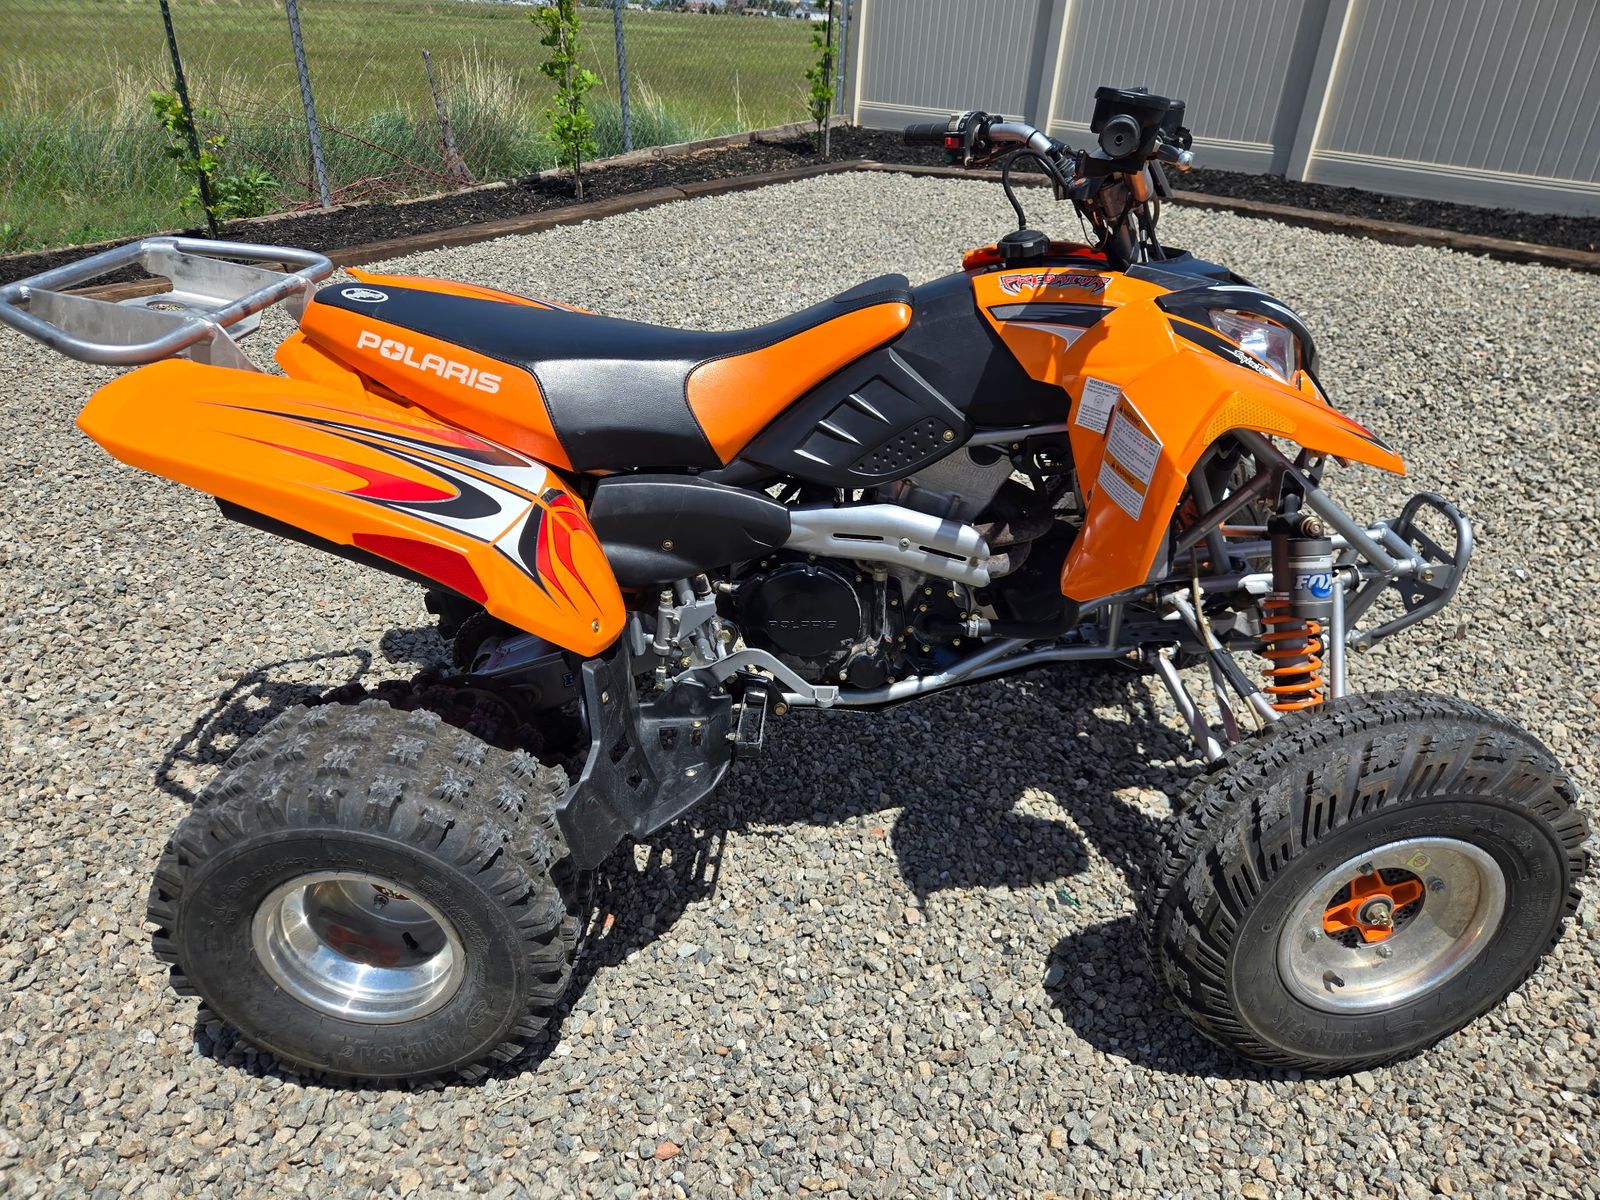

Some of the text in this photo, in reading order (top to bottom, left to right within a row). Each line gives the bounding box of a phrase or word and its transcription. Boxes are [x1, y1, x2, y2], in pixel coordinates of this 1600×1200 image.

[999, 273, 1113, 296] PREDATOR
[357, 330, 503, 394] POLARIS
[768, 619, 838, 629] POLARIS
